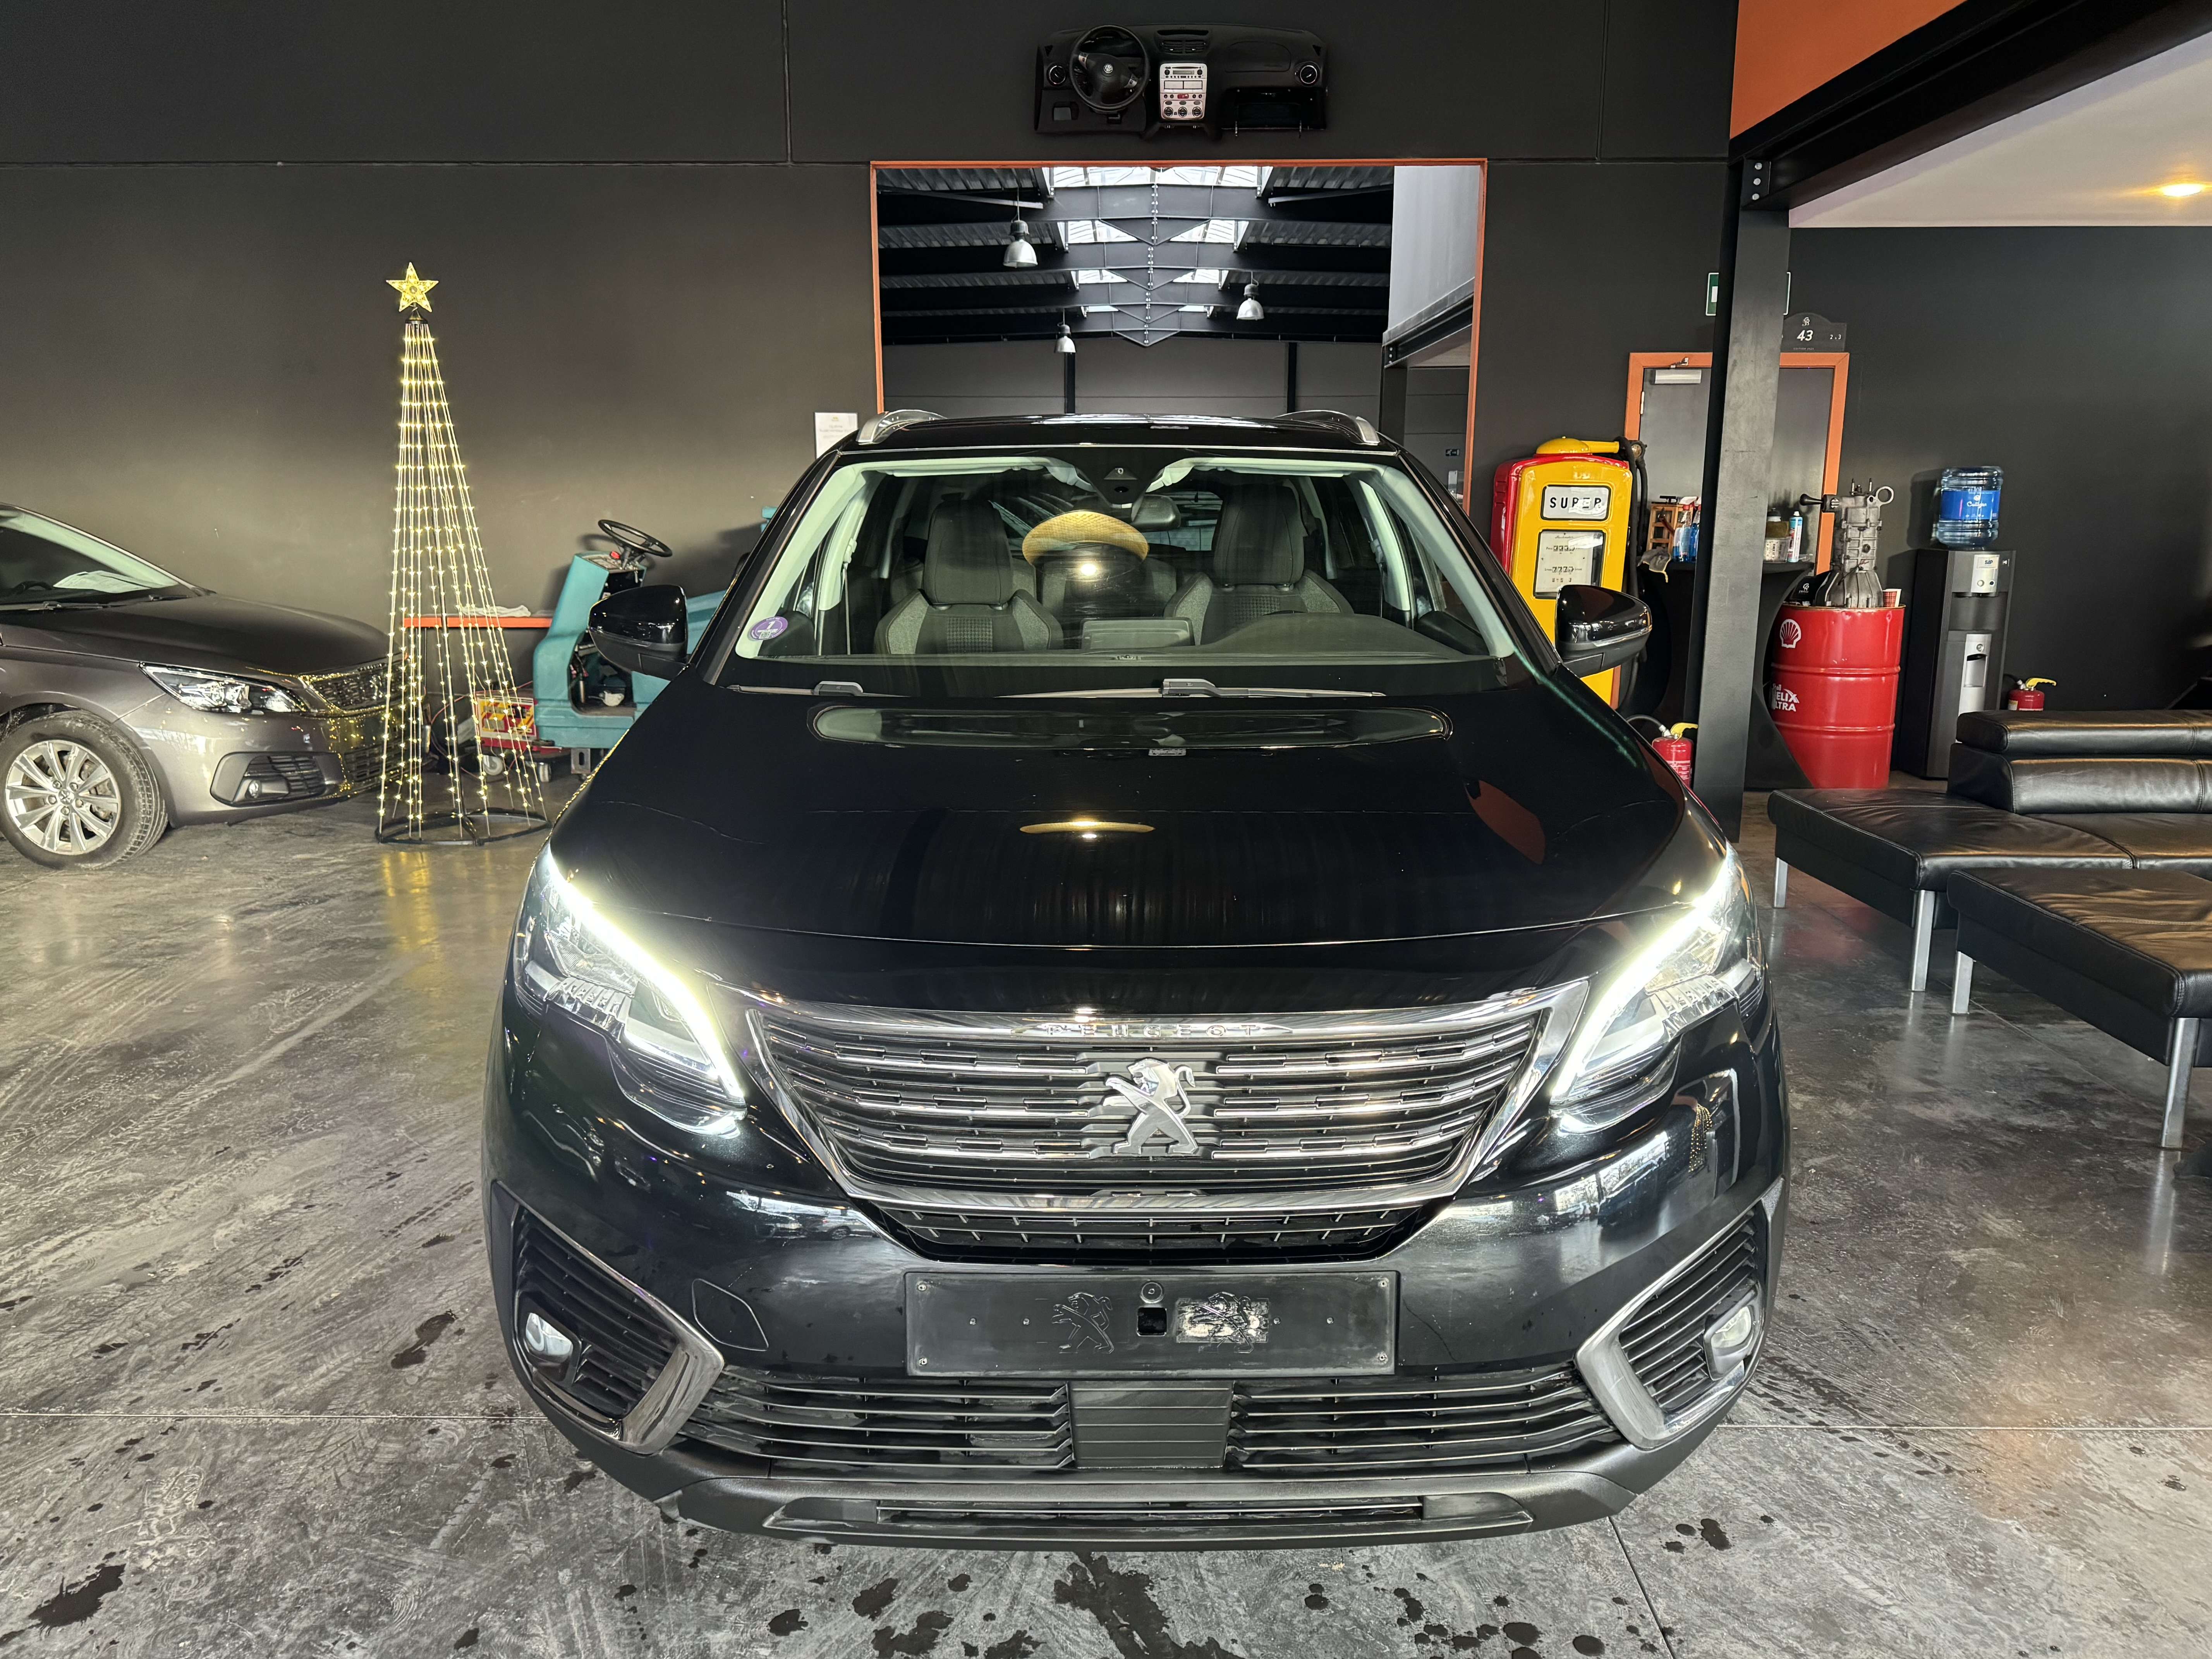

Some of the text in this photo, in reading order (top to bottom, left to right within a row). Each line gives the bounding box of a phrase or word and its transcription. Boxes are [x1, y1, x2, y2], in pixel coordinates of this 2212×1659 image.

[1796, 330, 1813, 341] 43
[1772, 689, 1800, 703] ELIX
[1771, 701, 1796, 712] LTRA
[1047, 1024, 1257, 1038] PEUGEOT
